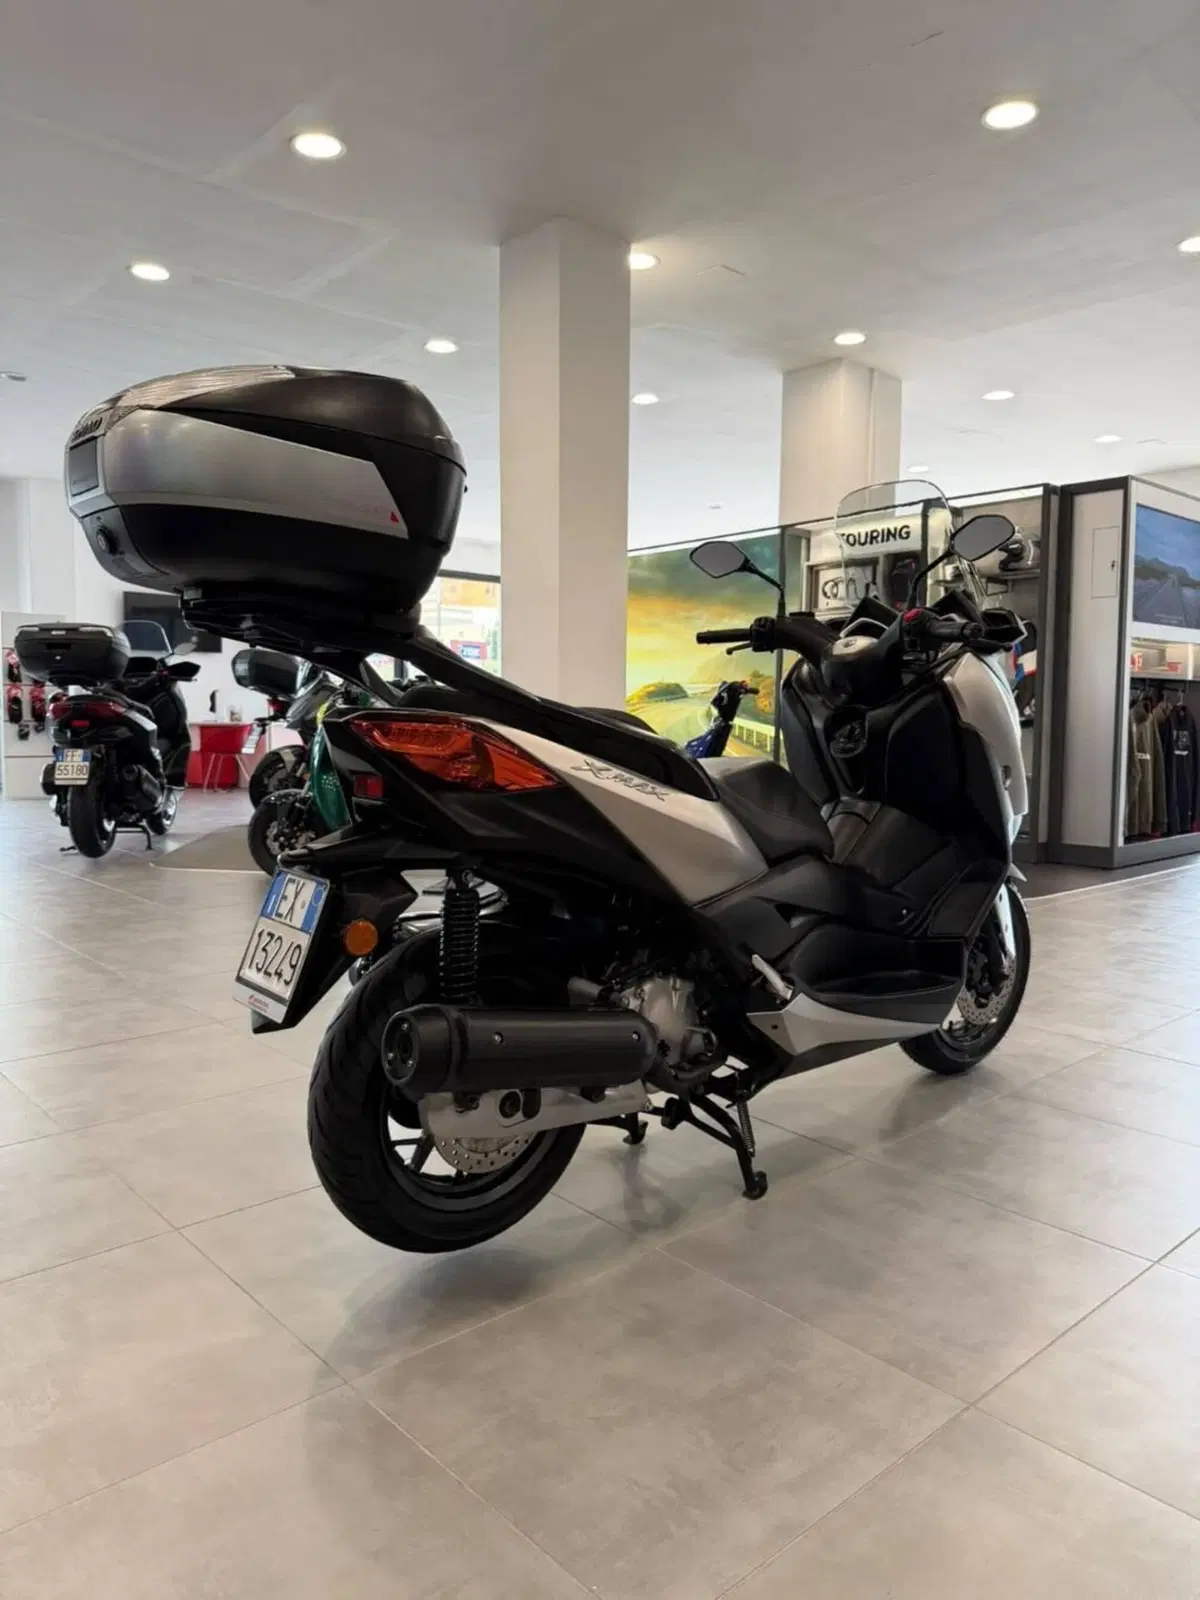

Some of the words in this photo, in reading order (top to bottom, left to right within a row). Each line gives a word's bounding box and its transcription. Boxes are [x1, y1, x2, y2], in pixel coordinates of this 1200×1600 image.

[56, 763, 89, 776] 55180
[273, 876, 305, 923] EX
[248, 928, 303, 986] 13249
